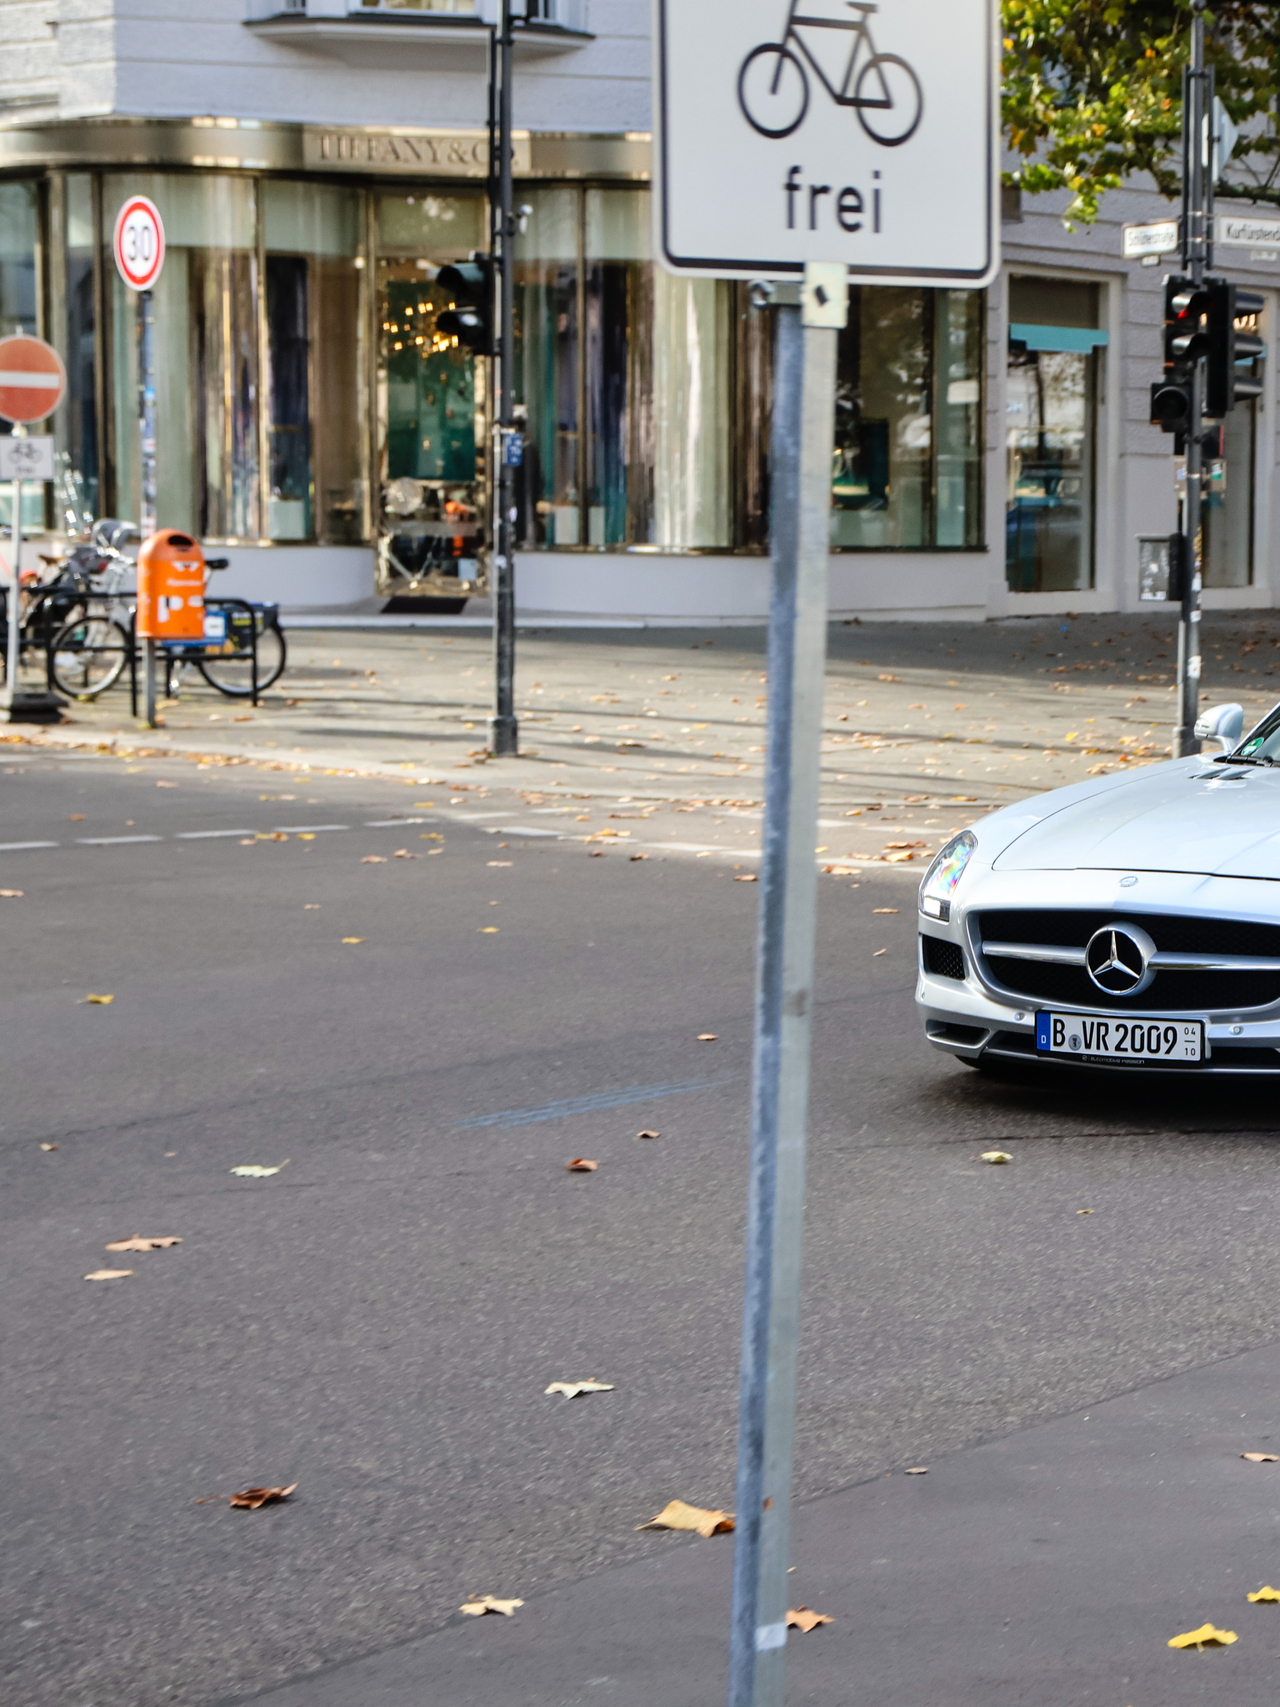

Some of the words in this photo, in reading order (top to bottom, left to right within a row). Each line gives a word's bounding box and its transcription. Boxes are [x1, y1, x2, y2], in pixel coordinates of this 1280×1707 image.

[784, 165, 881, 233] frei
[128, 226, 153, 261] 30
[1041, 1035, 1047, 1044] D
[1053, 1018, 1066, 1047] B
[1082, 1020, 1110, 1051] VR
[1114, 1024, 1178, 1055] 2009
[1184, 1027, 1196, 1036] 04
[1185, 1047, 1196, 1056] 10
